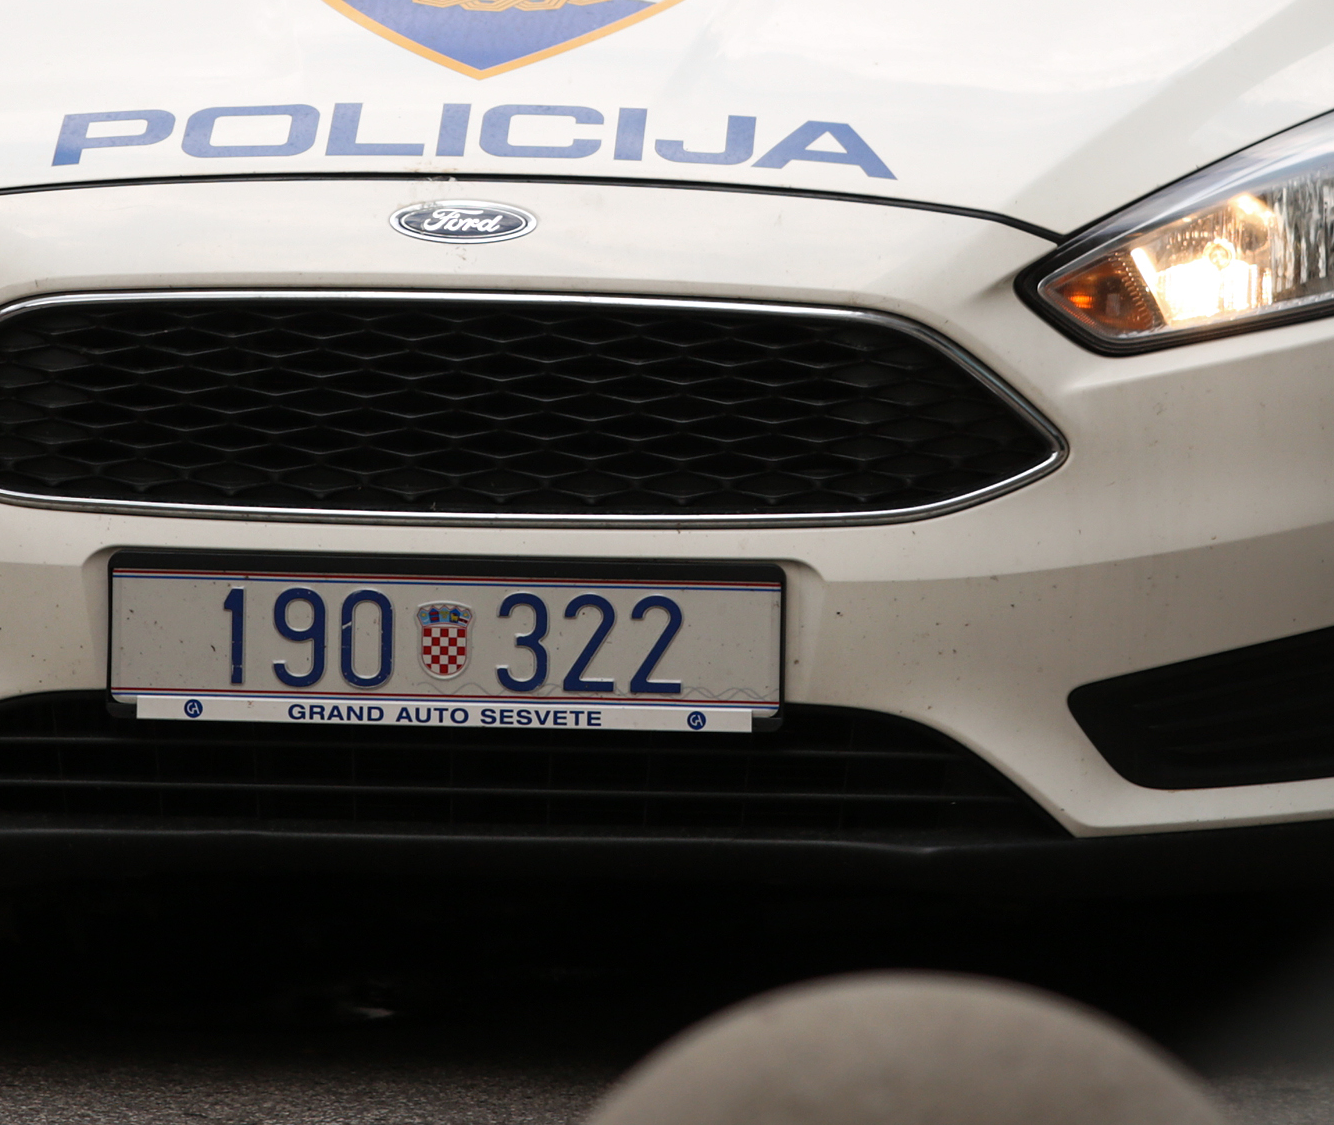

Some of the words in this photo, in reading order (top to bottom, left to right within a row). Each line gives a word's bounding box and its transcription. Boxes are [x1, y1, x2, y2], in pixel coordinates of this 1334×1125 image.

[51, 102, 898, 180] POLICIJA
[421, 207, 502, 234] Ford
[222, 586, 394, 688] 190
[495, 592, 684, 695] 322
[287, 703, 386, 722] GRAND
[394, 706, 471, 724] AUTO
[479, 708, 603, 728] SESVETE
